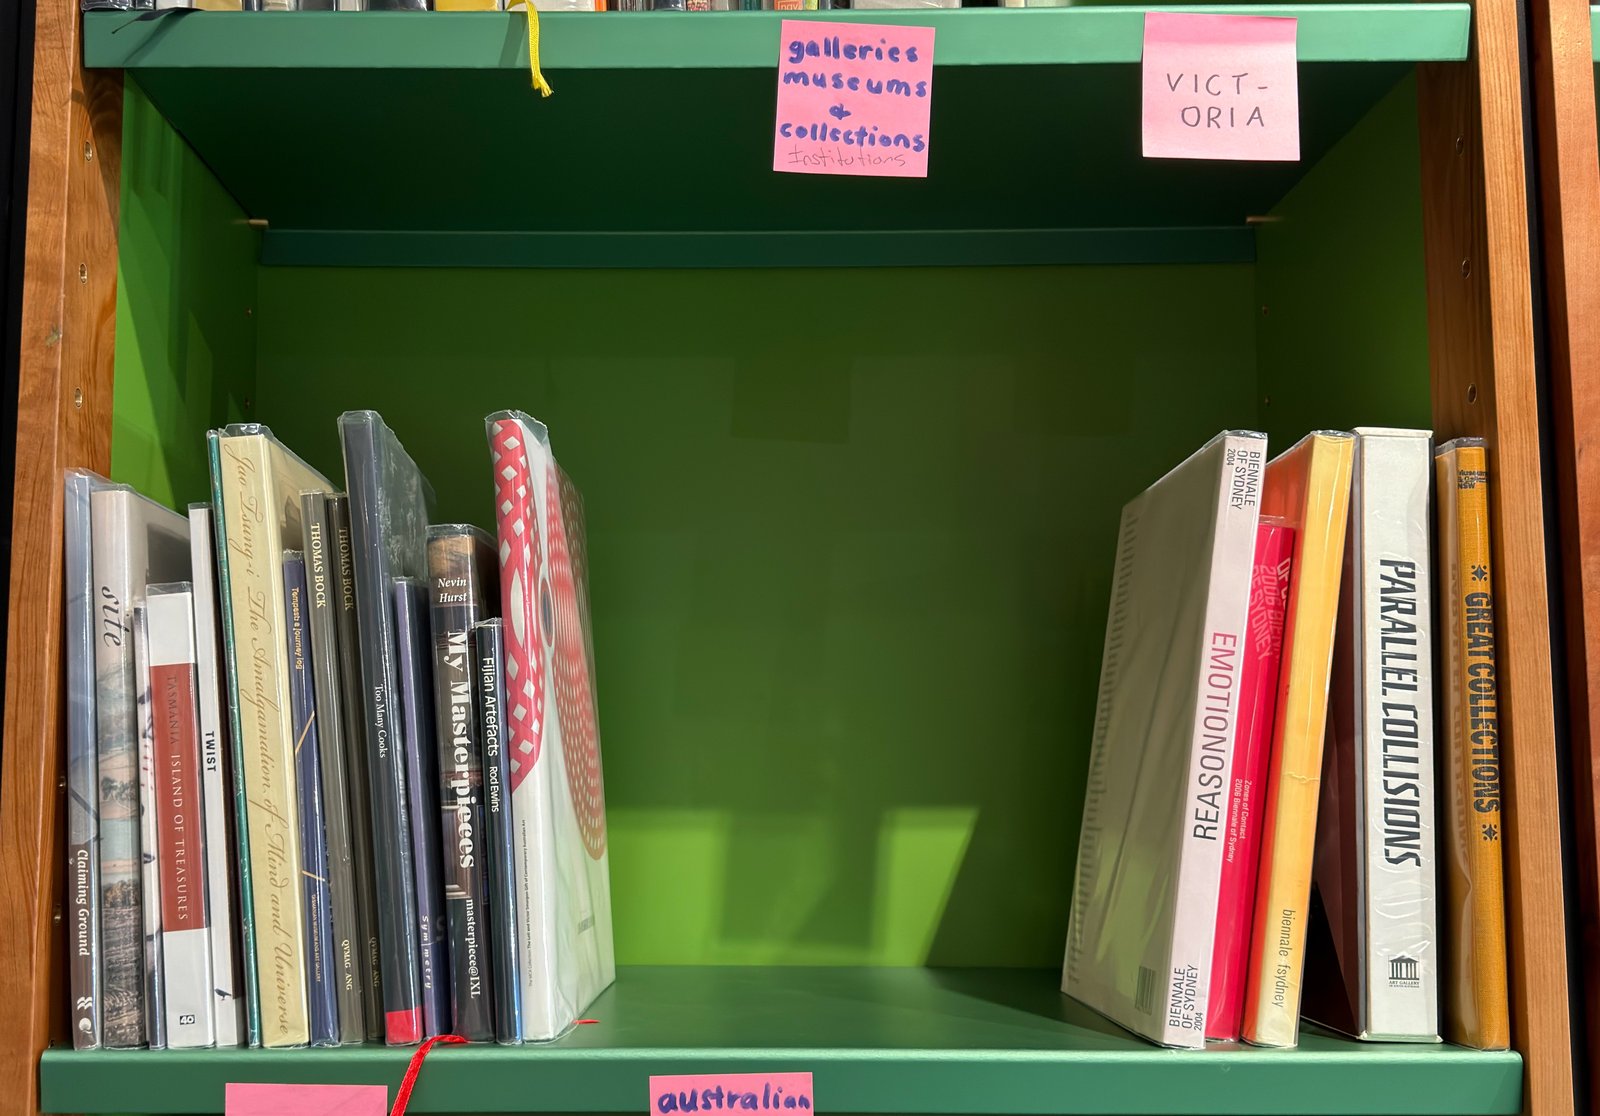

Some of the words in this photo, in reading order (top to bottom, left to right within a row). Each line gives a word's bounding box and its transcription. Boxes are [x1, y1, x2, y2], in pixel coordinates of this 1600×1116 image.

[788, 35, 918, 64] galleries
[783, 71, 927, 98] museums
[1167, 73, 1268, 96] VICT-
[1181, 106, 1264, 129] ORIA
[780, 122, 926, 152] collections
[788, 143, 906, 167] Institutions
[1226, 448, 1236, 466] 2004
[1236, 450, 1248, 463] OF
[1231, 466, 1247, 510] SYDNEY
[1243, 451, 1261, 507] BIENNALE
[310, 522, 324, 573] THOMAS
[338, 527, 351, 577] THOMAS
[314, 574, 327, 608] BOCK
[342, 578, 354, 611] BOCK
[438, 577, 467, 588] Nevin
[439, 592, 467, 603] Hurst
[101, 585, 130, 647] site
[247, 586, 272, 633] The
[1464, 591, 1495, 658] GREAT
[1379, 559, 1419, 697] PARALLEL
[295, 657, 304, 670] log
[444, 630, 468, 672] My
[482, 657, 494, 692] Fijian
[374, 683, 384, 702] Too
[167, 675, 179, 745] TASMANIA
[240, 638, 280, 794] Amalgamation
[374, 702, 385, 729] Many
[485, 694, 499, 757] Artefacts
[204, 731, 217, 772] TWIST
[378, 729, 387, 758] Cooks
[1467, 661, 1500, 814] COLLECTIONS
[171, 754, 183, 808] ISLAND
[450, 680, 477, 869] Masterpieces
[489, 766, 498, 784] Rod
[1234, 779, 1243, 797] 2006
[1243, 779, 1252, 801] Zones
[1381, 703, 1421, 868] COLLISIONS
[250, 799, 290, 829] of
[490, 784, 500, 813] Ewins
[1231, 797, 1241, 827] Biennale
[1242, 802, 1249, 811] of
[173, 814, 184, 832] OF
[1230, 828, 1237, 836] of
[1239, 811, 1249, 839] Contact
[265, 824, 289, 888] Mind
[1227, 837, 1237, 863] Sydney
[76, 850, 89, 904] Claiming
[174, 840, 188, 920] TREASURES
[78, 905, 90, 957] Ground
[269, 893, 292, 939] and
[464, 899, 481, 999] masterpiece@IXL
[1278, 909, 1296, 957] biennale
[341, 939, 351, 968] QVMAG
[368, 936, 378, 966] QVMAG
[273, 942, 293, 1035] Universe
[1169, 967, 1186, 1028] BIENNALE
[1184, 964, 1199, 1011] SYDNEY
[181, 1015, 194, 1024] 40
[1182, 1011, 1193, 1029] OF
[1193, 1012, 1203, 1031] 2004
[658, 1082, 811, 1114] australian
